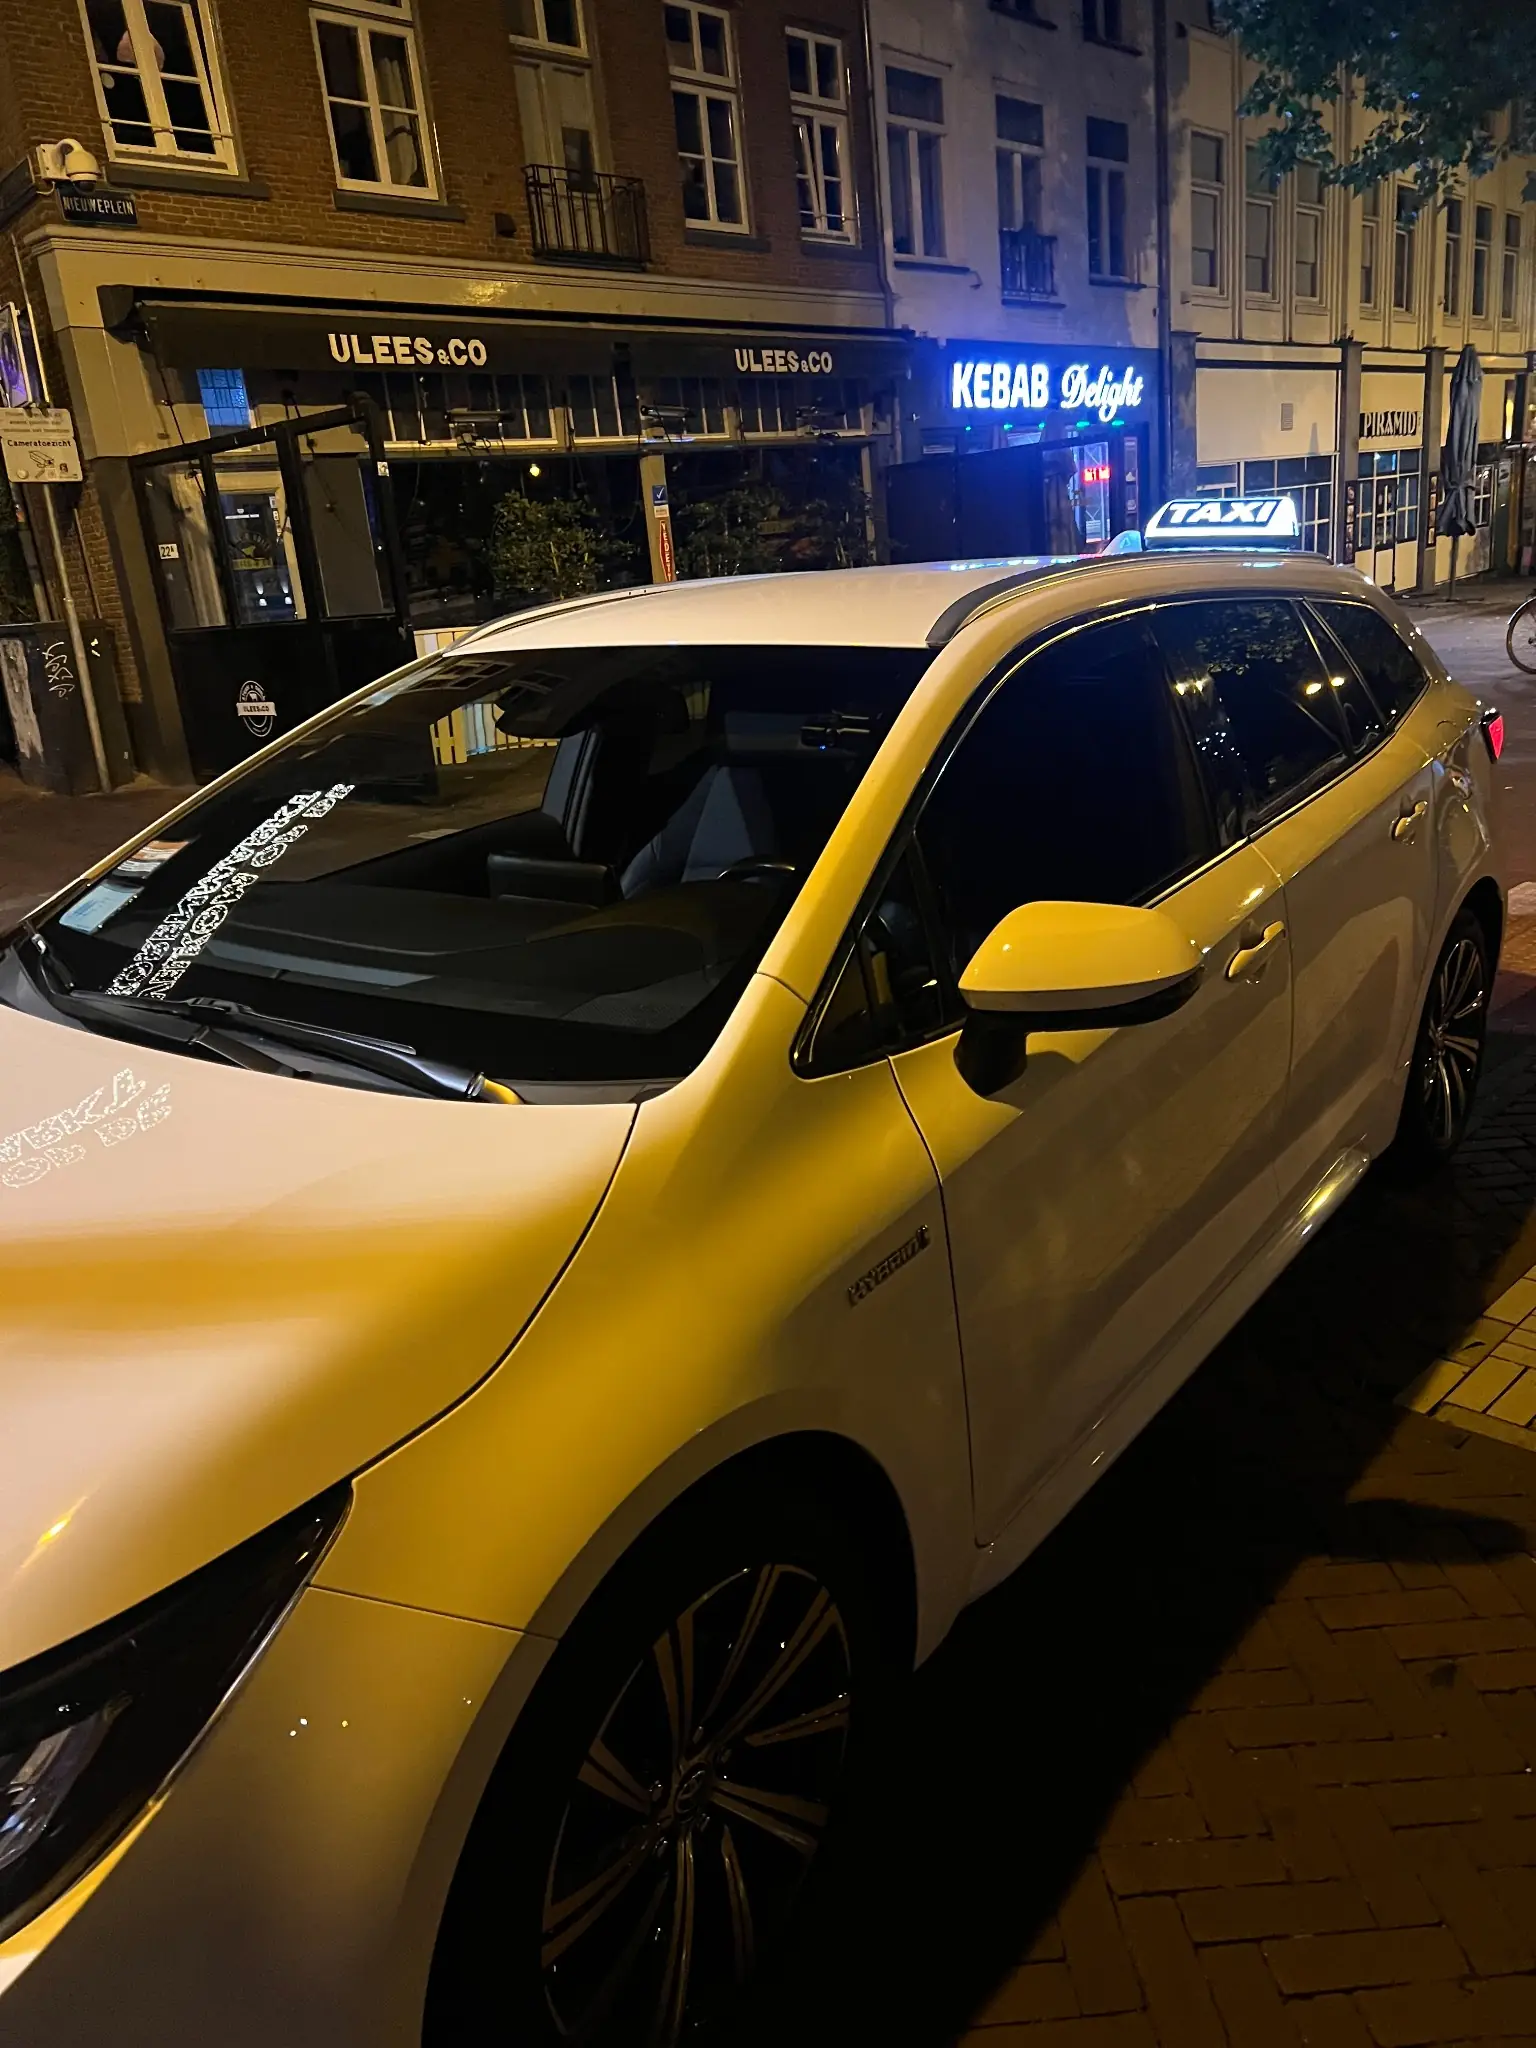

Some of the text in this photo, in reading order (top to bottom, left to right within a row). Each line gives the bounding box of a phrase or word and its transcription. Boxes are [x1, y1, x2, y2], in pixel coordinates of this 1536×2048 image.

[62, 196, 134, 215] NIEUWEPLEIN
[952, 361, 1144, 423] KEBAB Delight
[1363, 411, 1417, 437] PIRAMID
[7, 439, 72, 447] Cameratoezicht
[1169, 501, 1277, 524] TAXI
